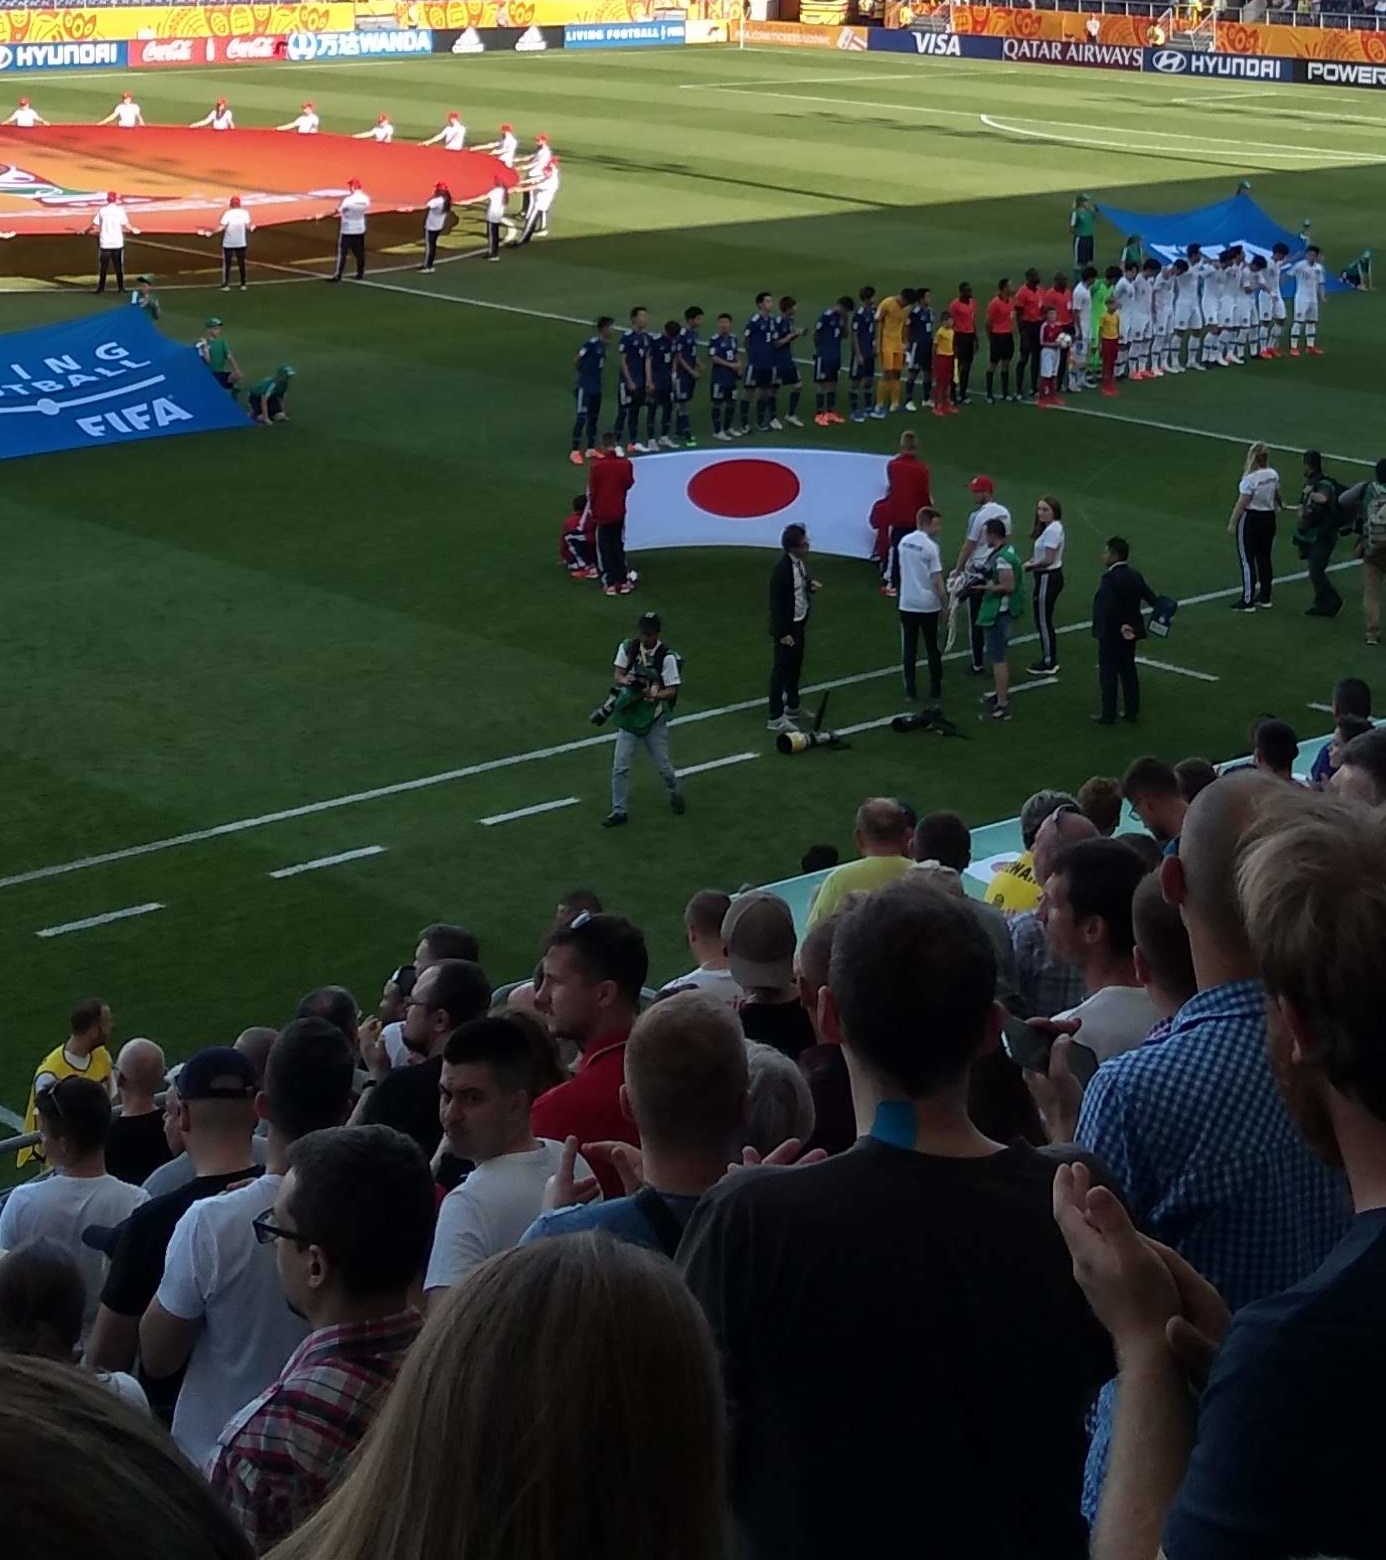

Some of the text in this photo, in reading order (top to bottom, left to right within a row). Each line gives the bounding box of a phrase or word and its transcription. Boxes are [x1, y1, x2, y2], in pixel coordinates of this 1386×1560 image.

[360, 31, 431, 54] WANDA
[912, 32, 961, 56] VISA
[1003, 39, 1142, 67] QATAR AIRWAYS
[16, 43, 116, 66] HYUNDAI
[1191, 55, 1281, 78] HYUNDAI
[75, 396, 195, 438] FIFA
